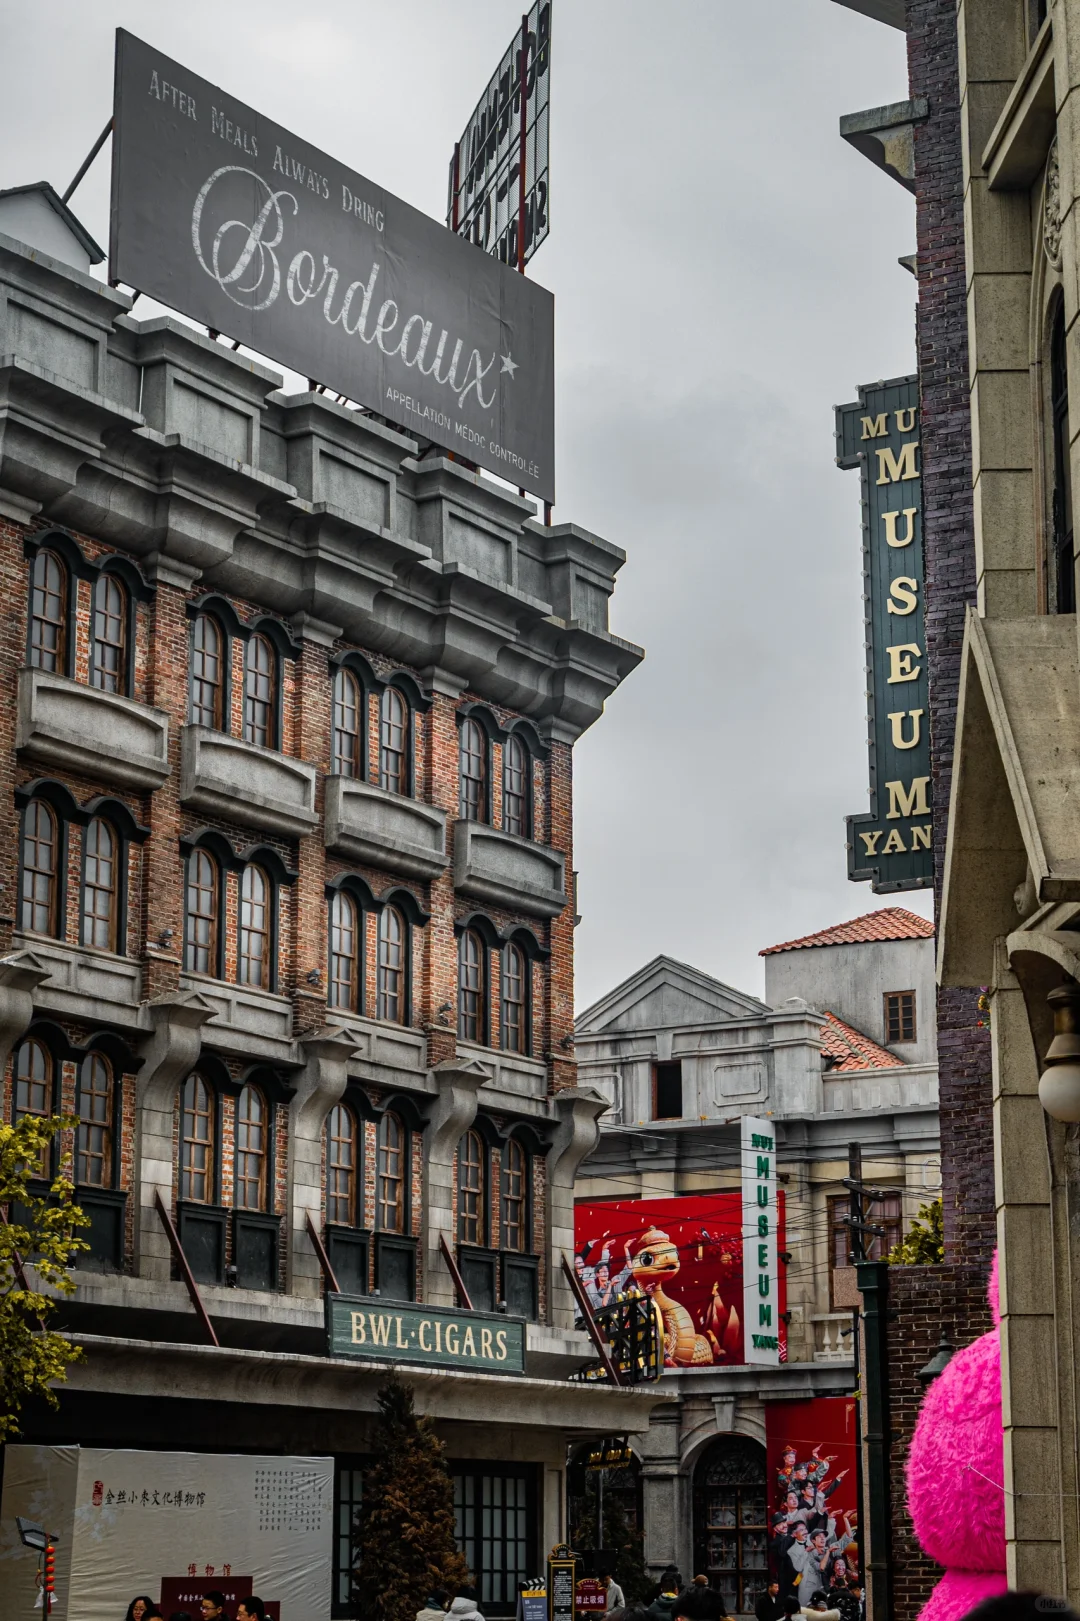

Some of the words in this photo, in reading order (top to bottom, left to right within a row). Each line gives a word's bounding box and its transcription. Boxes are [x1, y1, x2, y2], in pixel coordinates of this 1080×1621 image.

[148, 69, 198, 122] AFTER
[211, 106, 258, 157] MEALS
[272, 145, 330, 200] ALWAYS
[342, 184, 385, 233] DRING
[191, 165, 497, 410] Bordeaux
[386, 387, 451, 430] APPELLATION
[455, 422, 486, 449] MÉDOC
[874, 441, 931, 820] MUSEUM
[756, 1155, 772, 1327] MUSEUM
[105, 1488, 206, 1508] 金丝小枣文化博物馆
[187, 1563, 232, 1577] 博物馆
[575, 1595, 605, 1605] 禁止吸烟
